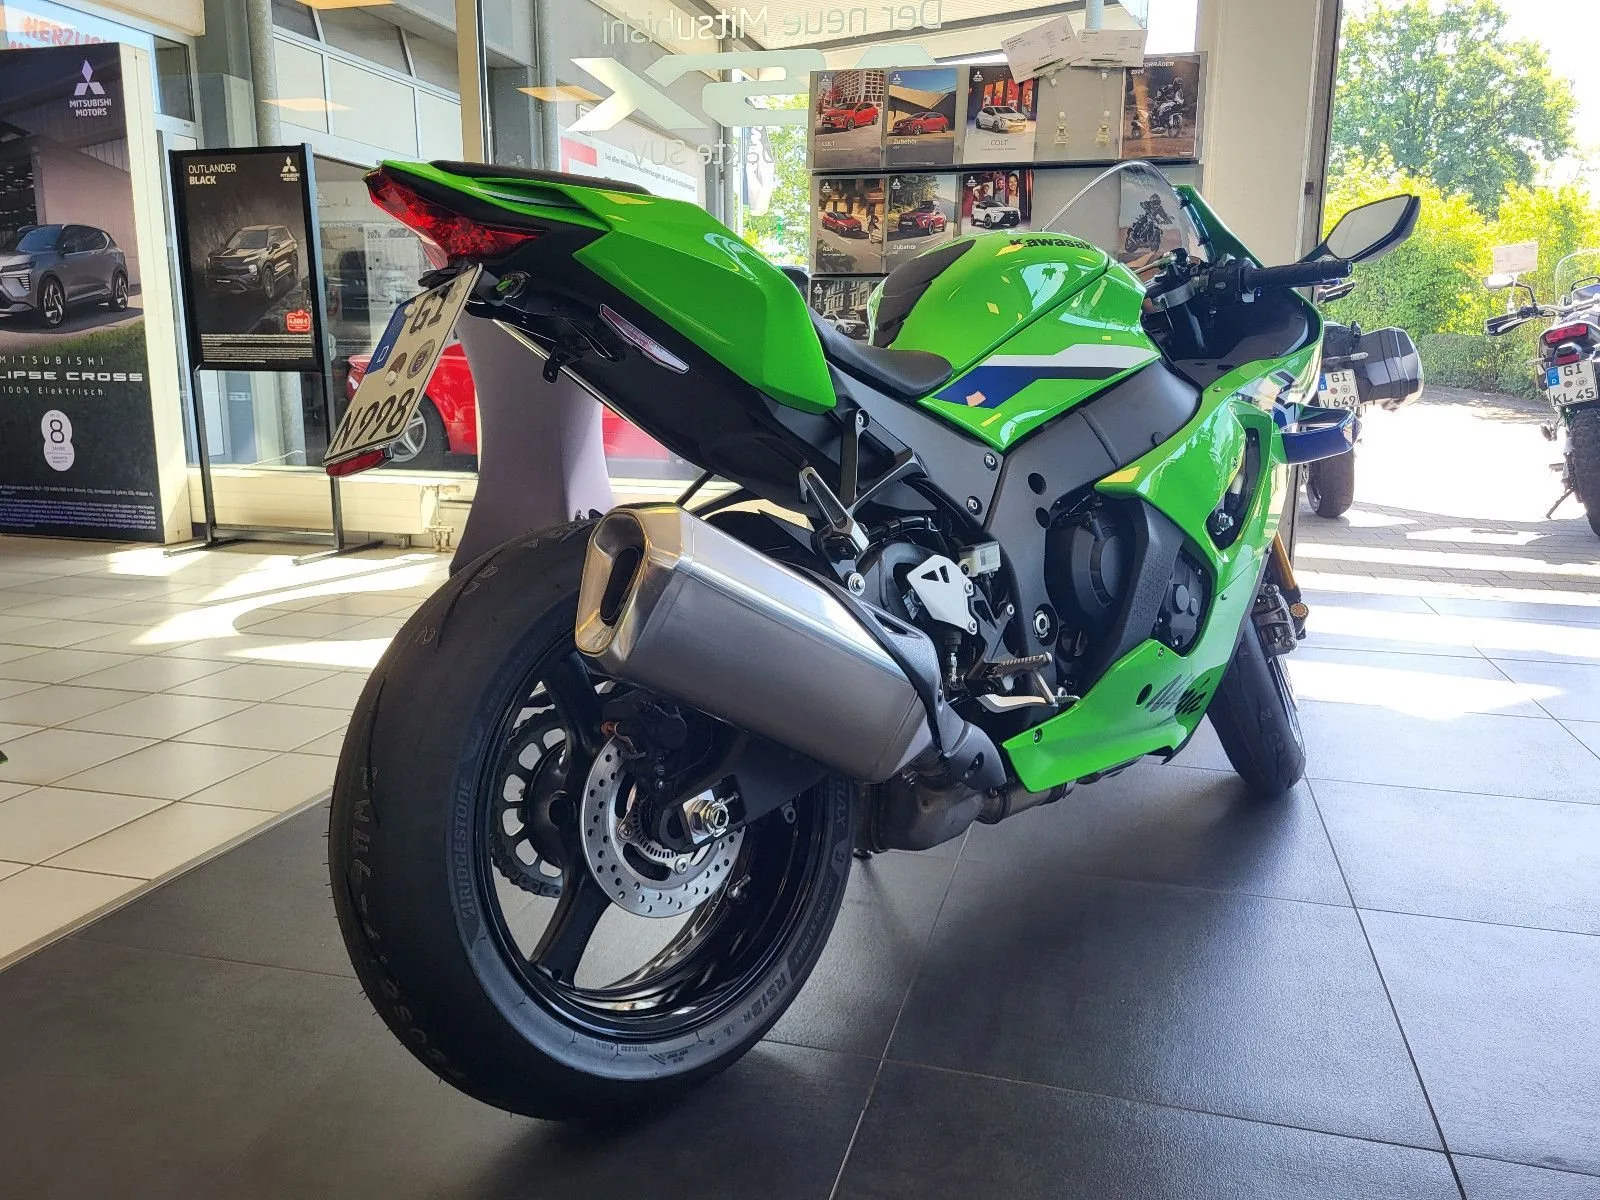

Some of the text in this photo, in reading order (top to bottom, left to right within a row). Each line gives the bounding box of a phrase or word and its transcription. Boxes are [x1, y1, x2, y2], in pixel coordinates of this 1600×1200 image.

[69, 98, 112, 108] MITSUBISHI
[75, 107, 107, 117] MOTORS
[188, 163, 237, 174] OUTLANDER
[189, 174, 216, 185] BLACK
[408, 280, 456, 335] GI
[377, 345, 389, 363] D
[0, 355, 104, 366] MITSUBISHI
[1563, 363, 1583, 377] GI
[66, 371, 143, 382] CROSS
[1331, 372, 1347, 383] GI
[3, 386, 29, 394] 100%
[1333, 395, 1356, 408] 649
[1552, 387, 1595, 405] KL 45
[49, 419, 65, 444] 8
[454, 780, 477, 922] BRIDGESTONE
